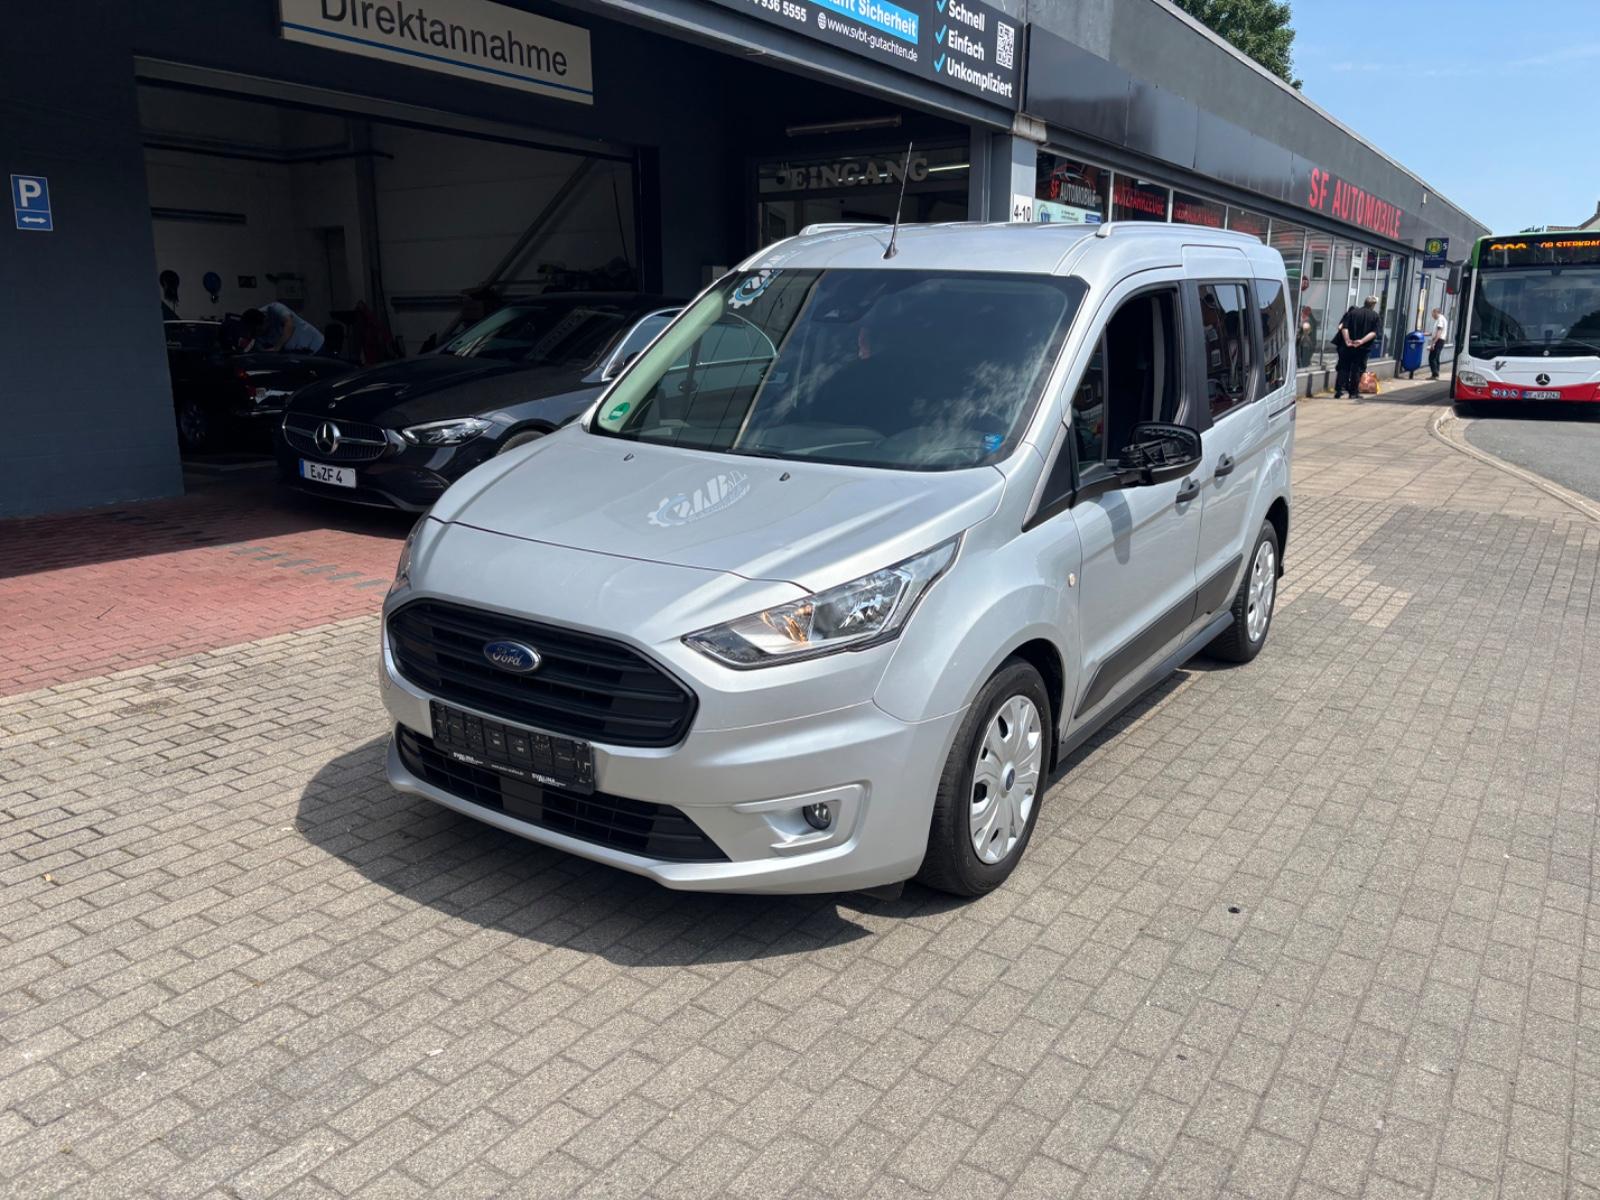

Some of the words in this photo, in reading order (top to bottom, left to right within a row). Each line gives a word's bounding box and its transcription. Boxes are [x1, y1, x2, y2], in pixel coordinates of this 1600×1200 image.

[782, 1, 807, 22] 5555
[858, 0, 917, 37] Sicherheit
[948, 0, 986, 32] Schnell
[320, 0, 568, 76] Direktannahme
[827, 18, 918, 62] www.svbt-gutachten.de
[948, 29, 985, 61] Einfach
[946, 57, 1012, 98] Unkompliziert
[789, 157, 928, 190] EINGANG
[18, 178, 42, 207] P
[1308, 167, 1330, 210] SF
[1331, 179, 1401, 239] AUTOMOBILE
[321, 466, 334, 482] ZF
